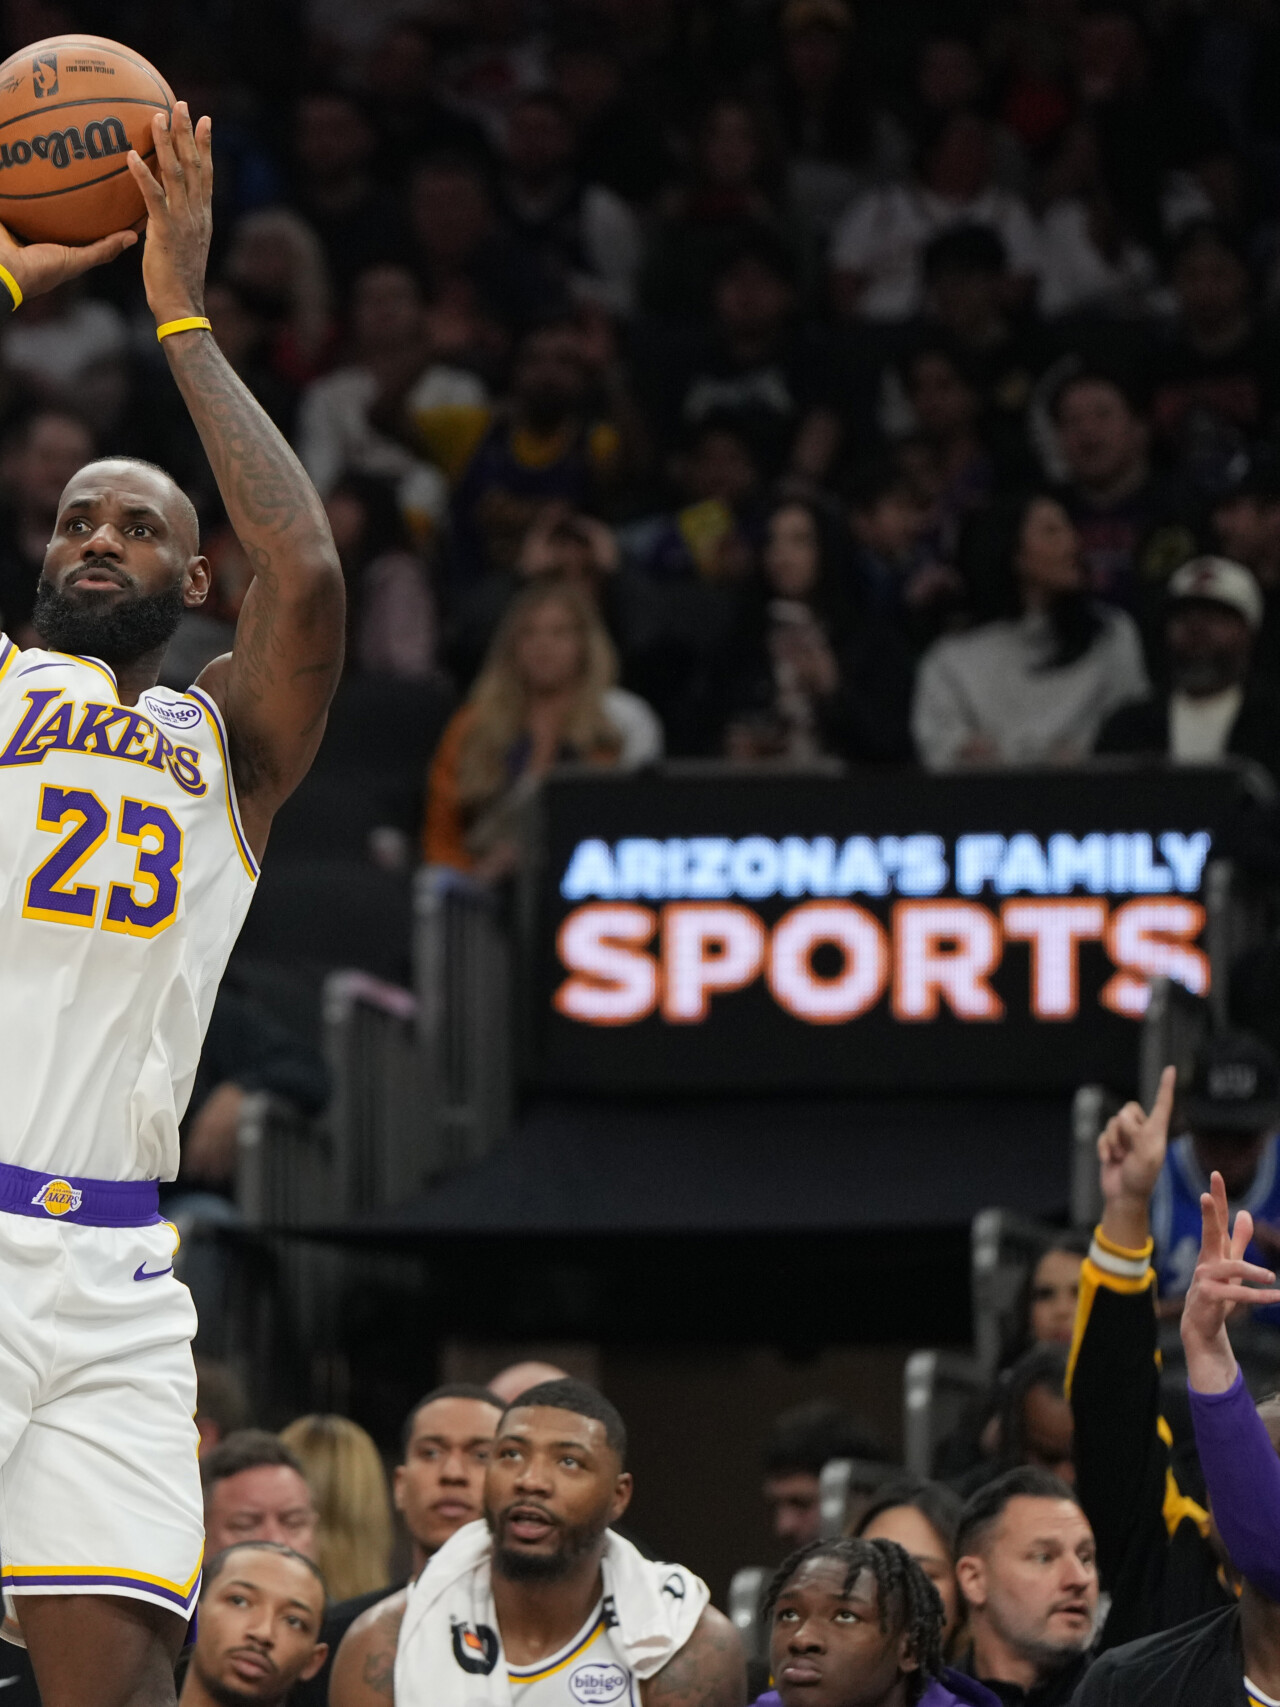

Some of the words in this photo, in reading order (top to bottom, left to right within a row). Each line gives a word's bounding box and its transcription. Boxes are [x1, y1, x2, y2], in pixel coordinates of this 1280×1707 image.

[147, 699, 197, 722] bibigo
[22, 782, 185, 939] 23
[562, 834, 949, 899] ARIZONA'S
[955, 830, 1212, 895] FAMILY
[552, 896, 1212, 1024] SPORTS
[36, 1186, 81, 1210] LAKERS
[574, 1673, 624, 1691] bibigo
